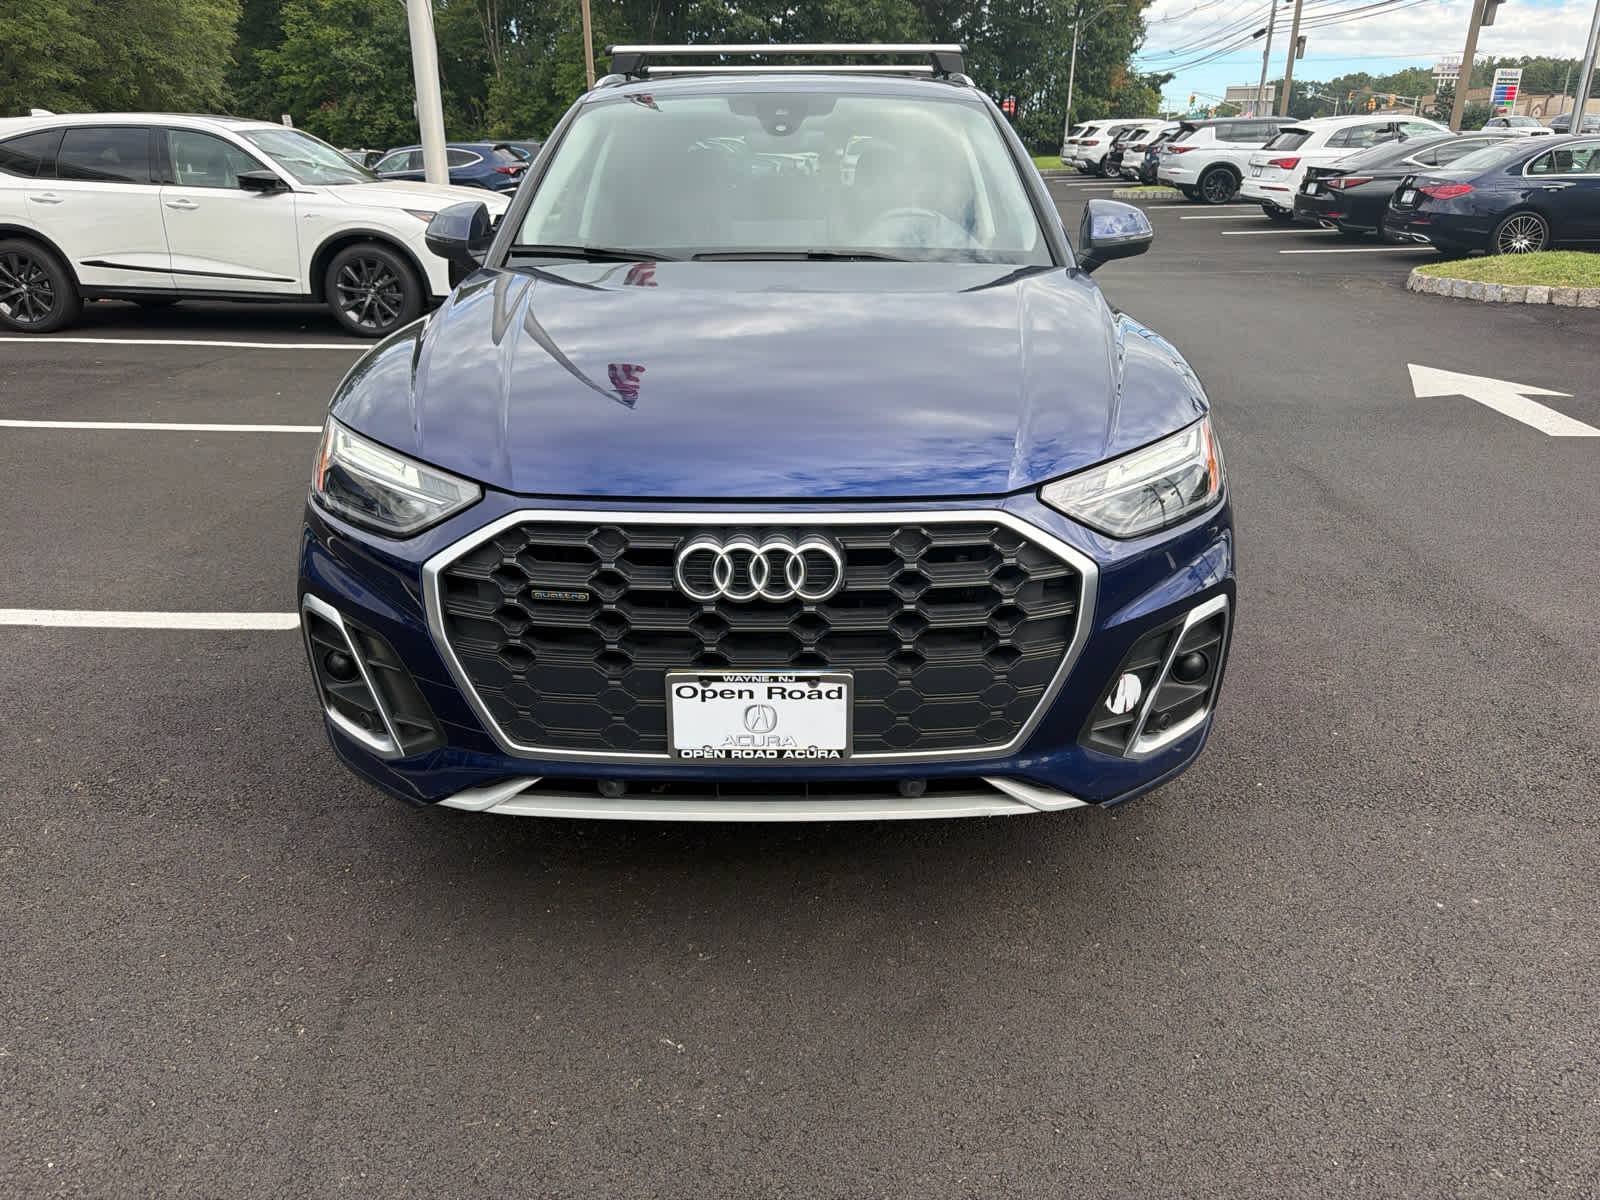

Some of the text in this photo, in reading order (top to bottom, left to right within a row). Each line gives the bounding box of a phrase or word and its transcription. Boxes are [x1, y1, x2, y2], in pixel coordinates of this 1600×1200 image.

[778, 675, 796, 683] NJ
[675, 685, 843, 702] Open Road
[721, 735, 798, 747] ACURA
[680, 750, 841, 759] OPEN ROAD ACURA
